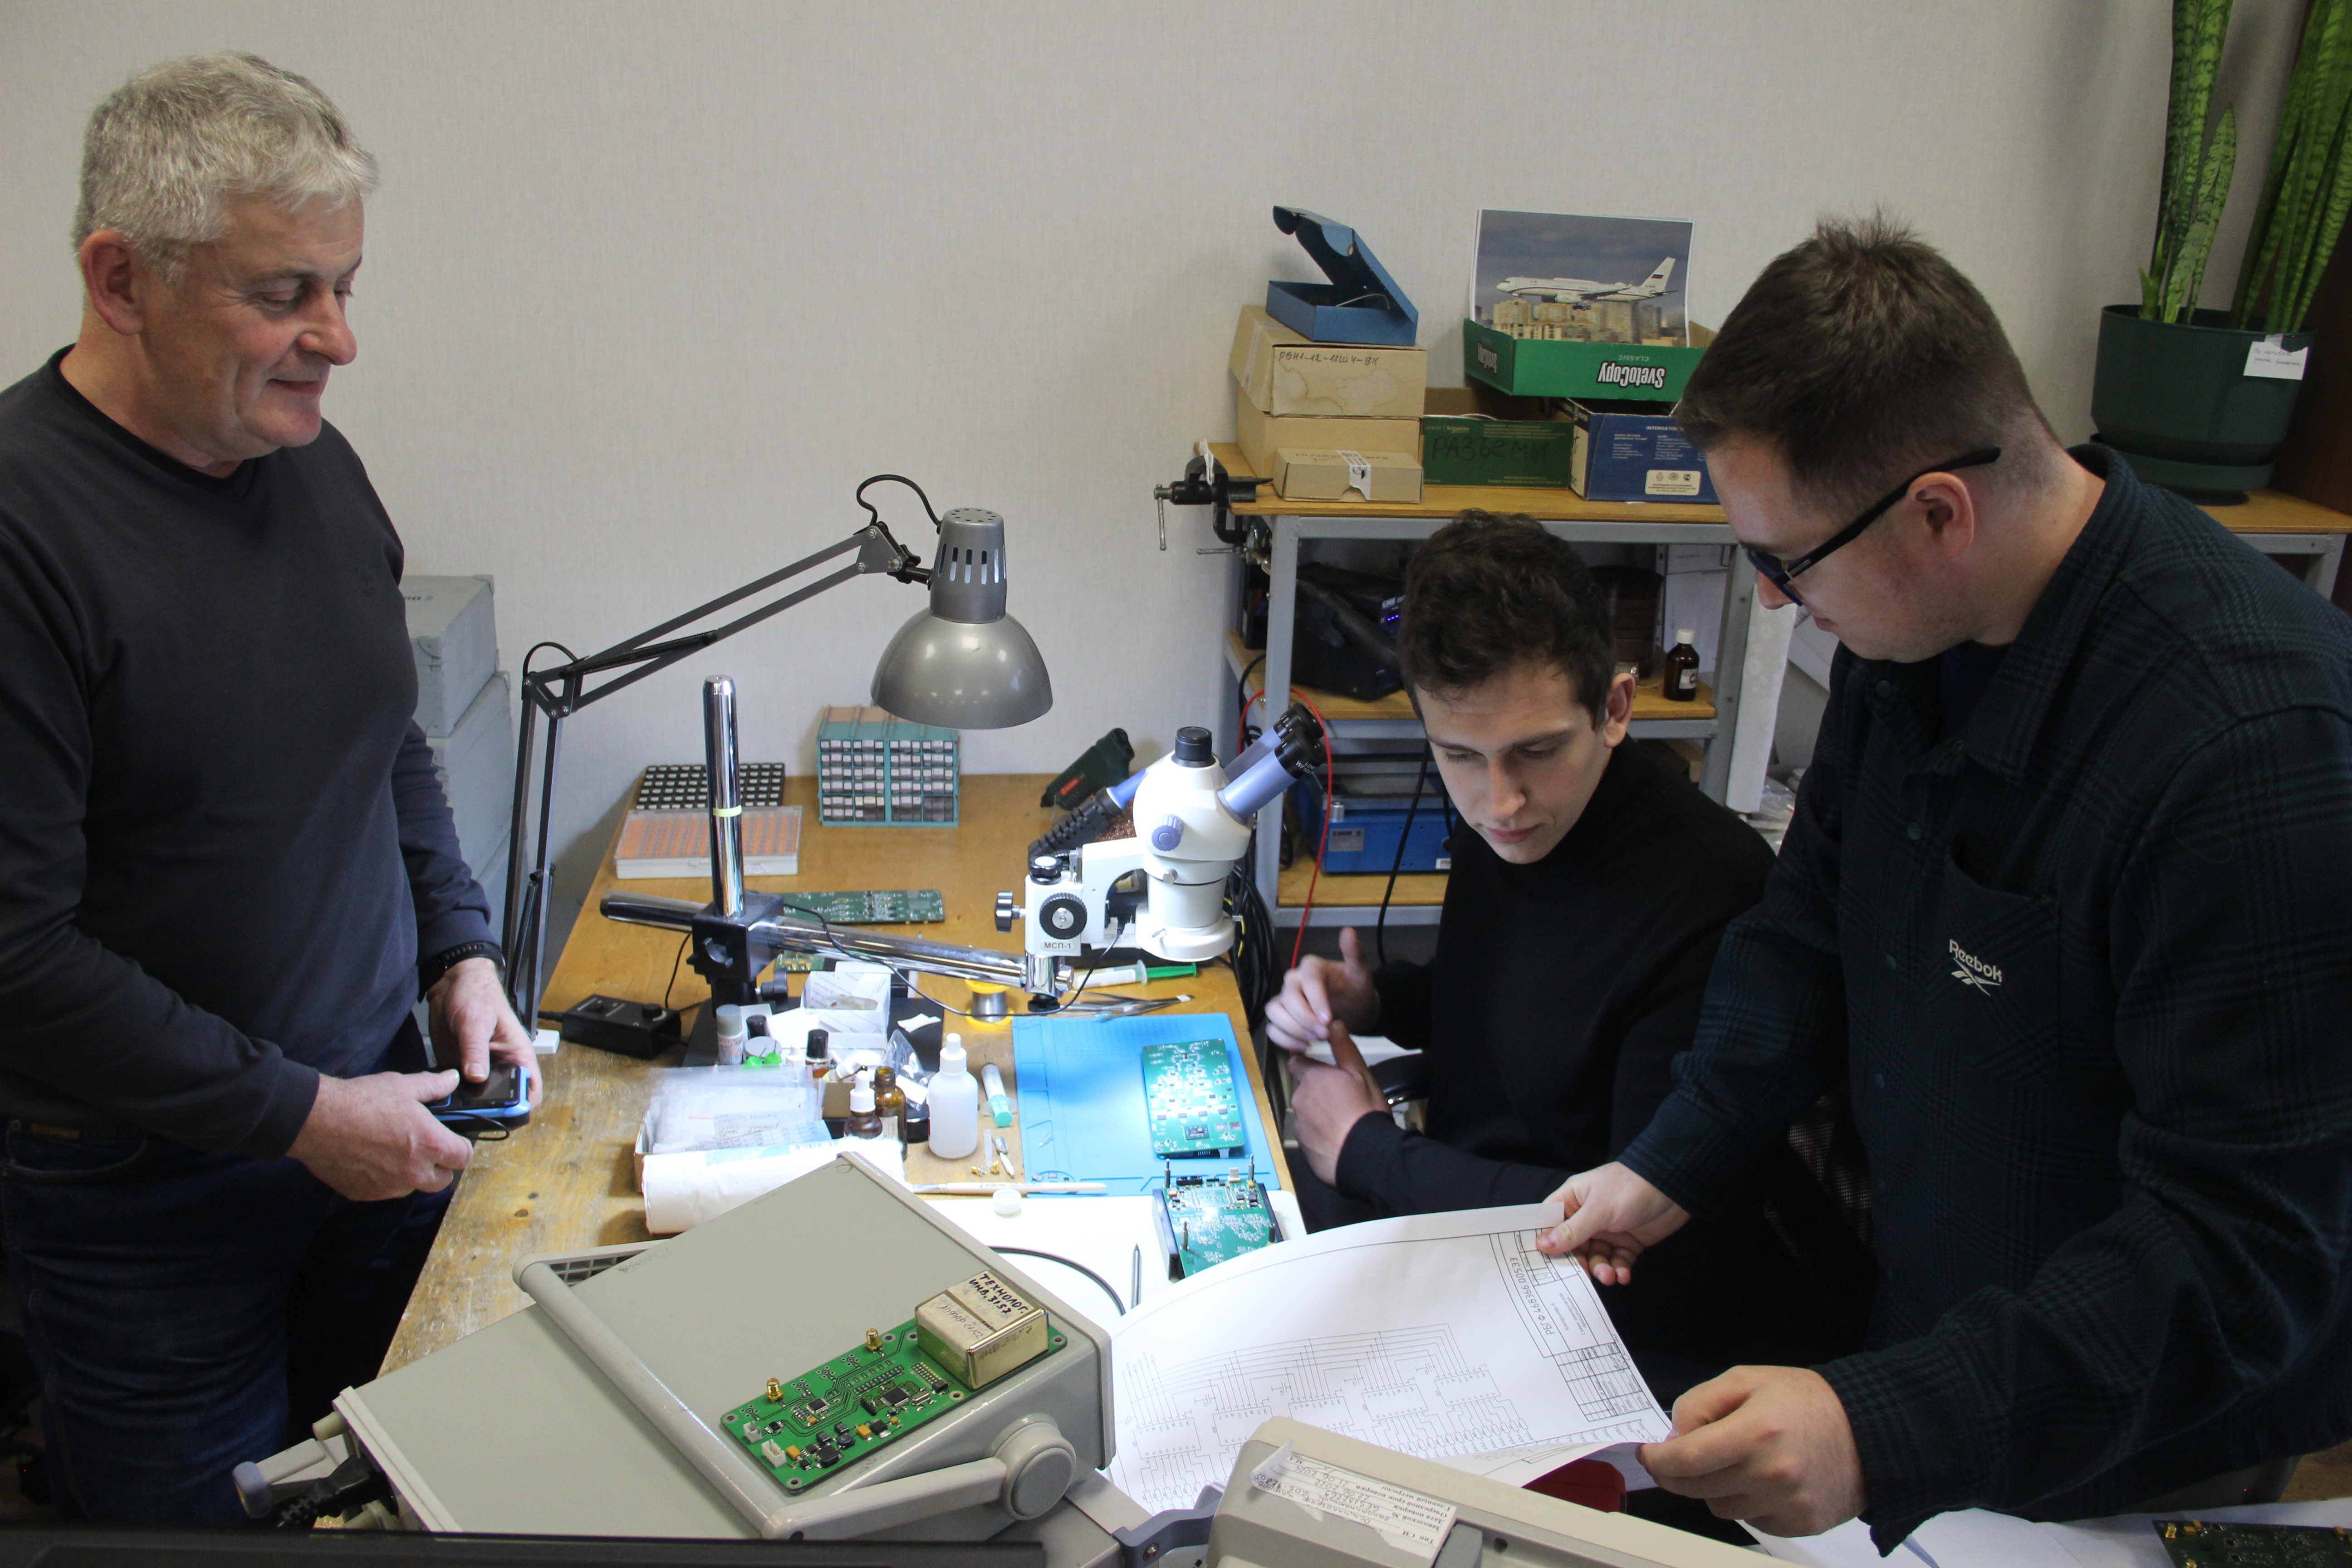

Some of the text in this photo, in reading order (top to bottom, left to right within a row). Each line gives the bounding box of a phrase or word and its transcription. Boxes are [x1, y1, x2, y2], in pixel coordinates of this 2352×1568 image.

[1597, 362, 1665, 389] SvetoCopy
[1949, 939, 2003, 983] Reebok
[969, 1279, 1011, 1314] ИНВ. 3157
[1355, 1485, 1447, 1518] Очередной срок поверки
[1381, 1486, 1450, 1511] Главный метролог
[1393, 1504, 1445, 1524] Дата поверки
[1402, 1515, 1440, 1531] Заводской
[1419, 1535, 1434, 1544] Тип
